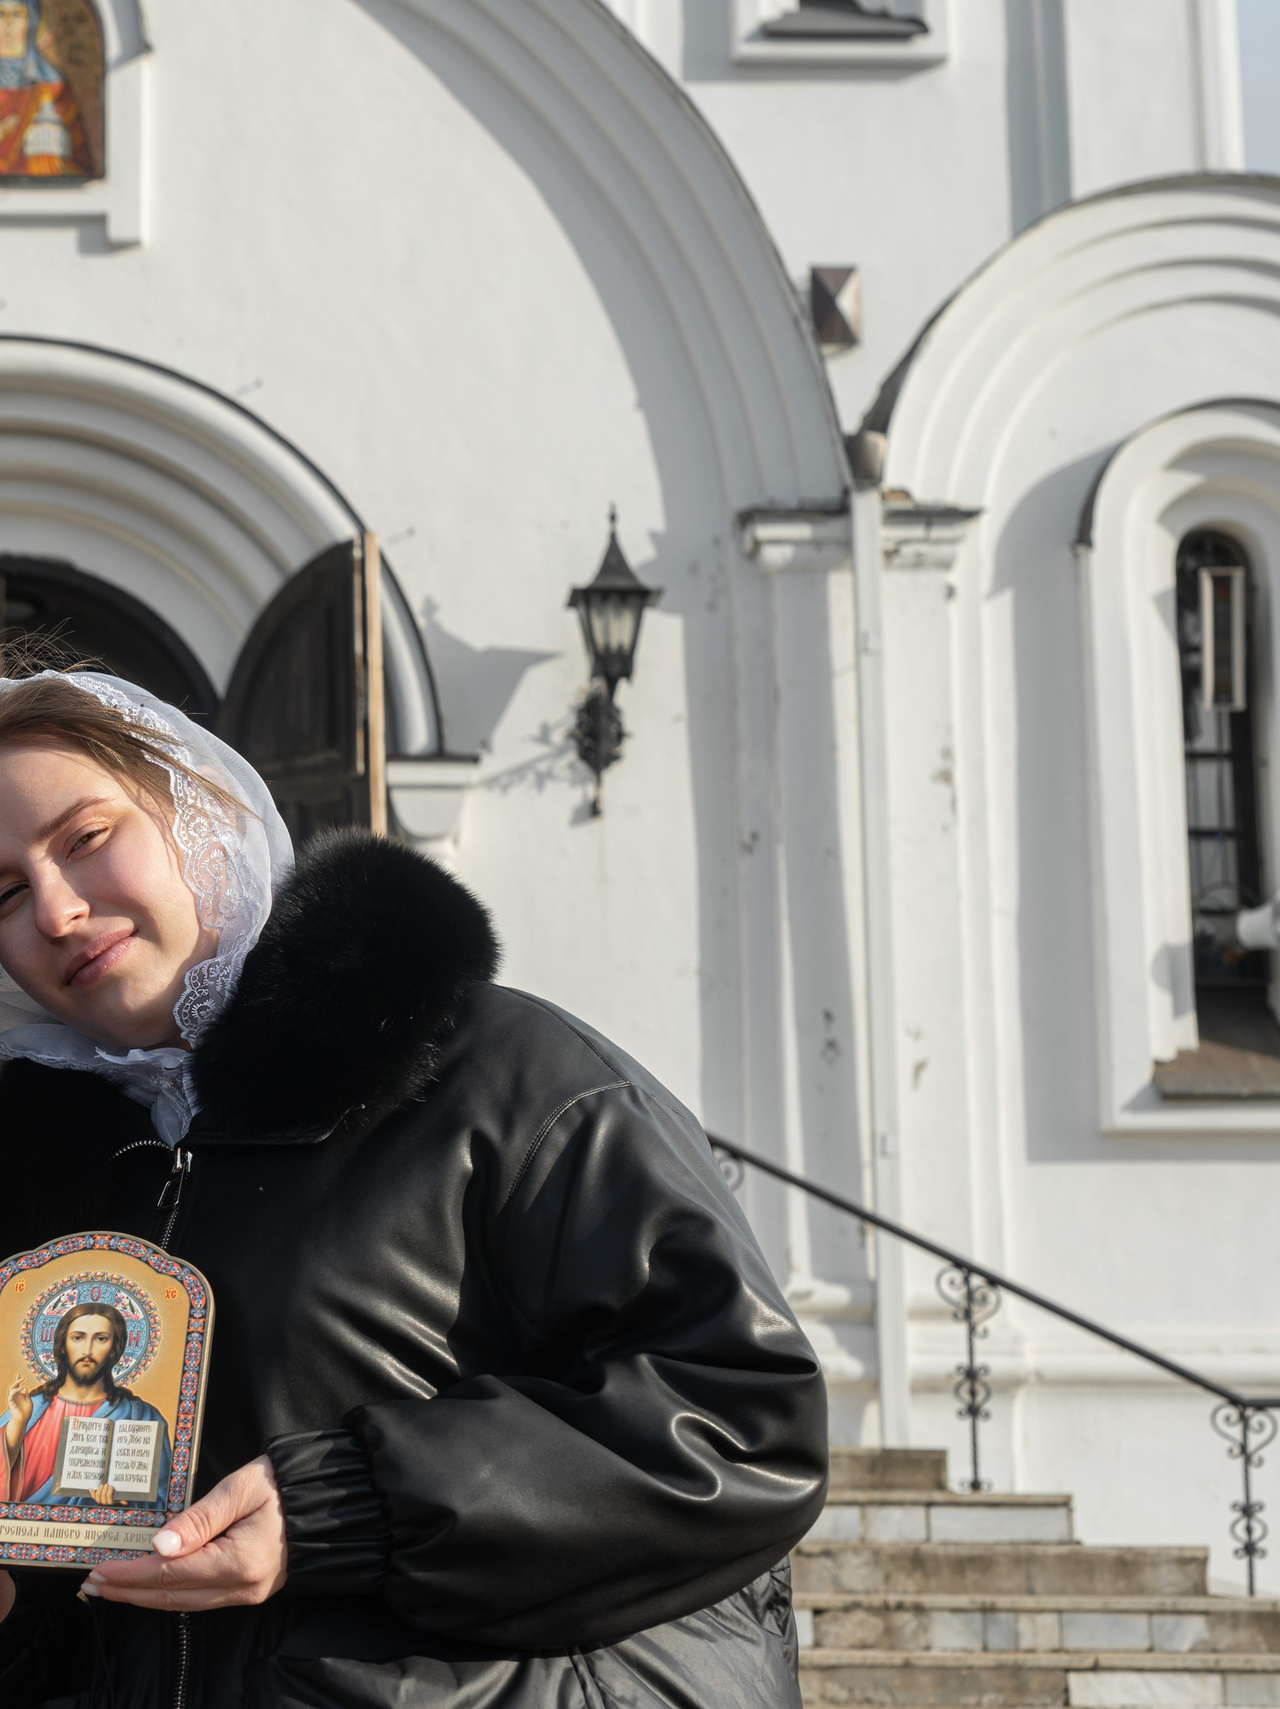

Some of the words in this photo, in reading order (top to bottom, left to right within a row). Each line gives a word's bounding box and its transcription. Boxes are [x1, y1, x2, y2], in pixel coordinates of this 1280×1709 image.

[0, 1524, 40, 1537] ГОСПОДА
[43, 1527, 81, 1540] НАШЕГО
[84, 1529, 119, 1543] ИИСУСА
